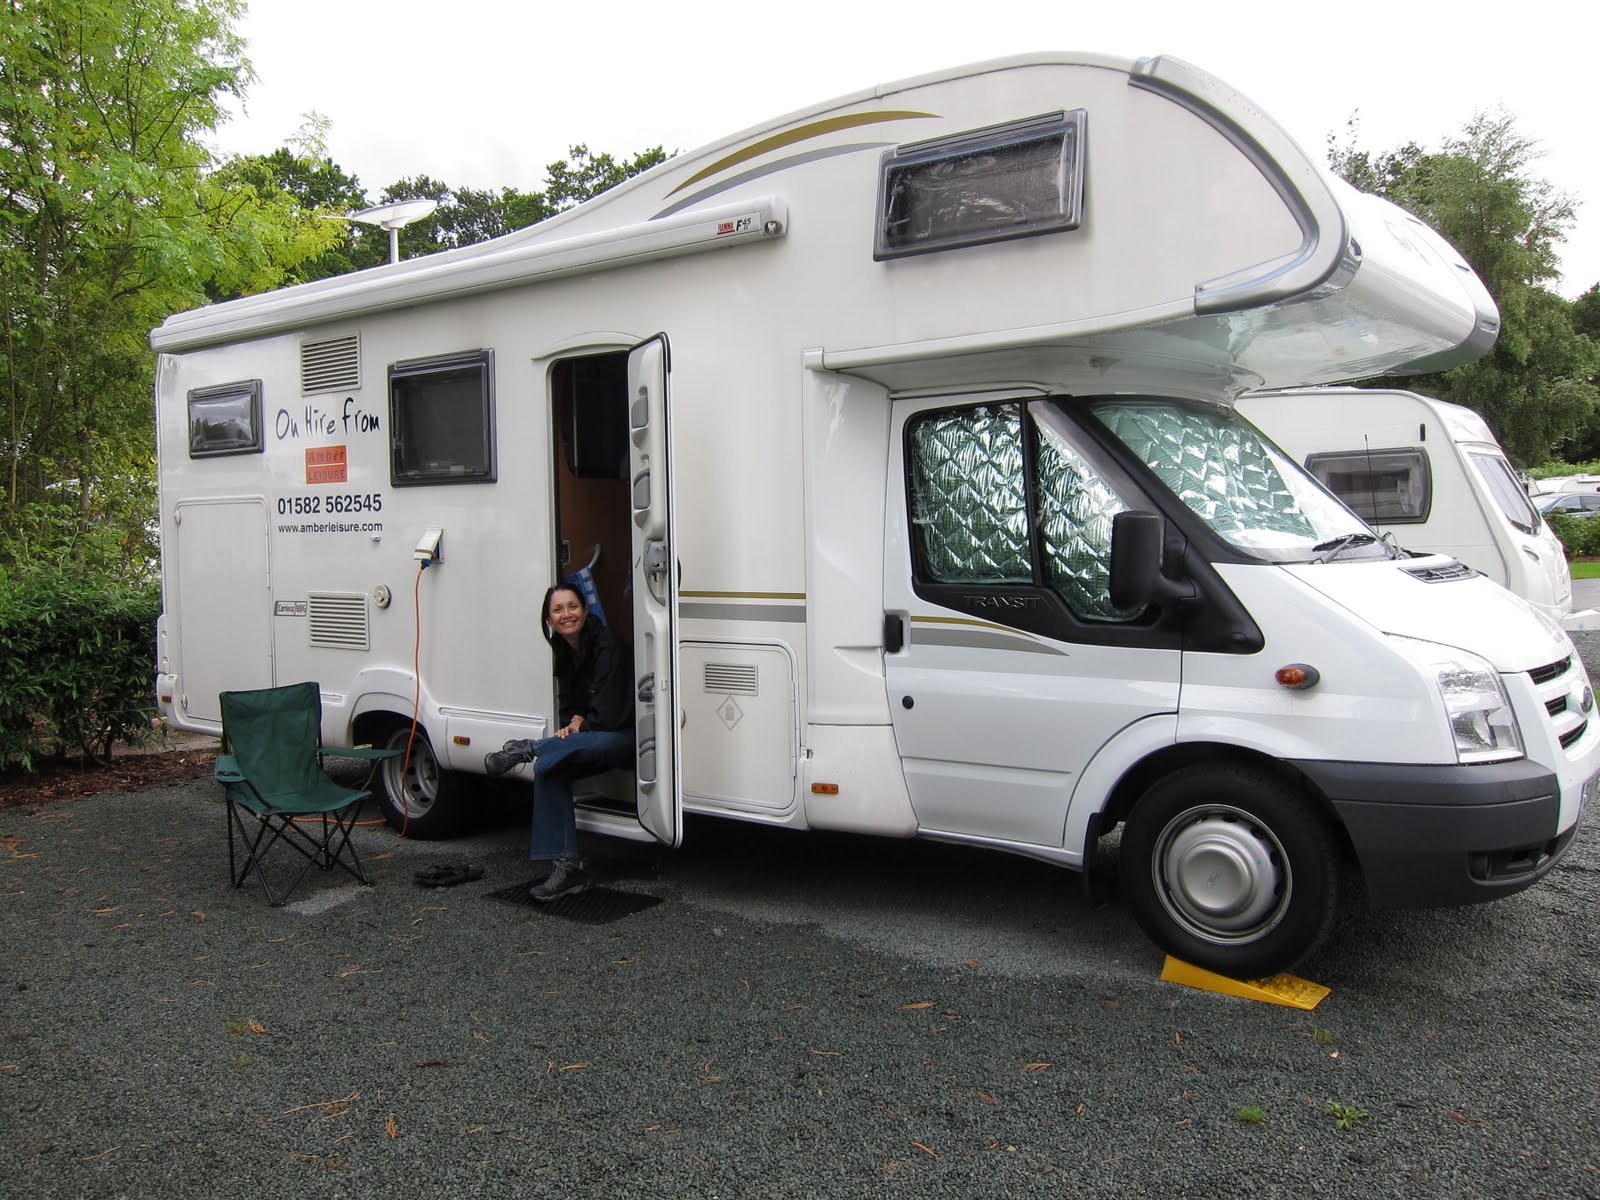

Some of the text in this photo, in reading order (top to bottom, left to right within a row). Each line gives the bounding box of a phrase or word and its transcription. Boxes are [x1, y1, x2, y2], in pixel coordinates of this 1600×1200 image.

[276, 408, 299, 440] On
[305, 405, 337, 436] Hire
[308, 451, 345, 462] Amber
[308, 469, 345, 480] LEISURE
[277, 494, 382, 514] 01582 562545
[278, 522, 383, 533] www.amberleisure.com
[963, 595, 1041, 608] TRANSIT
